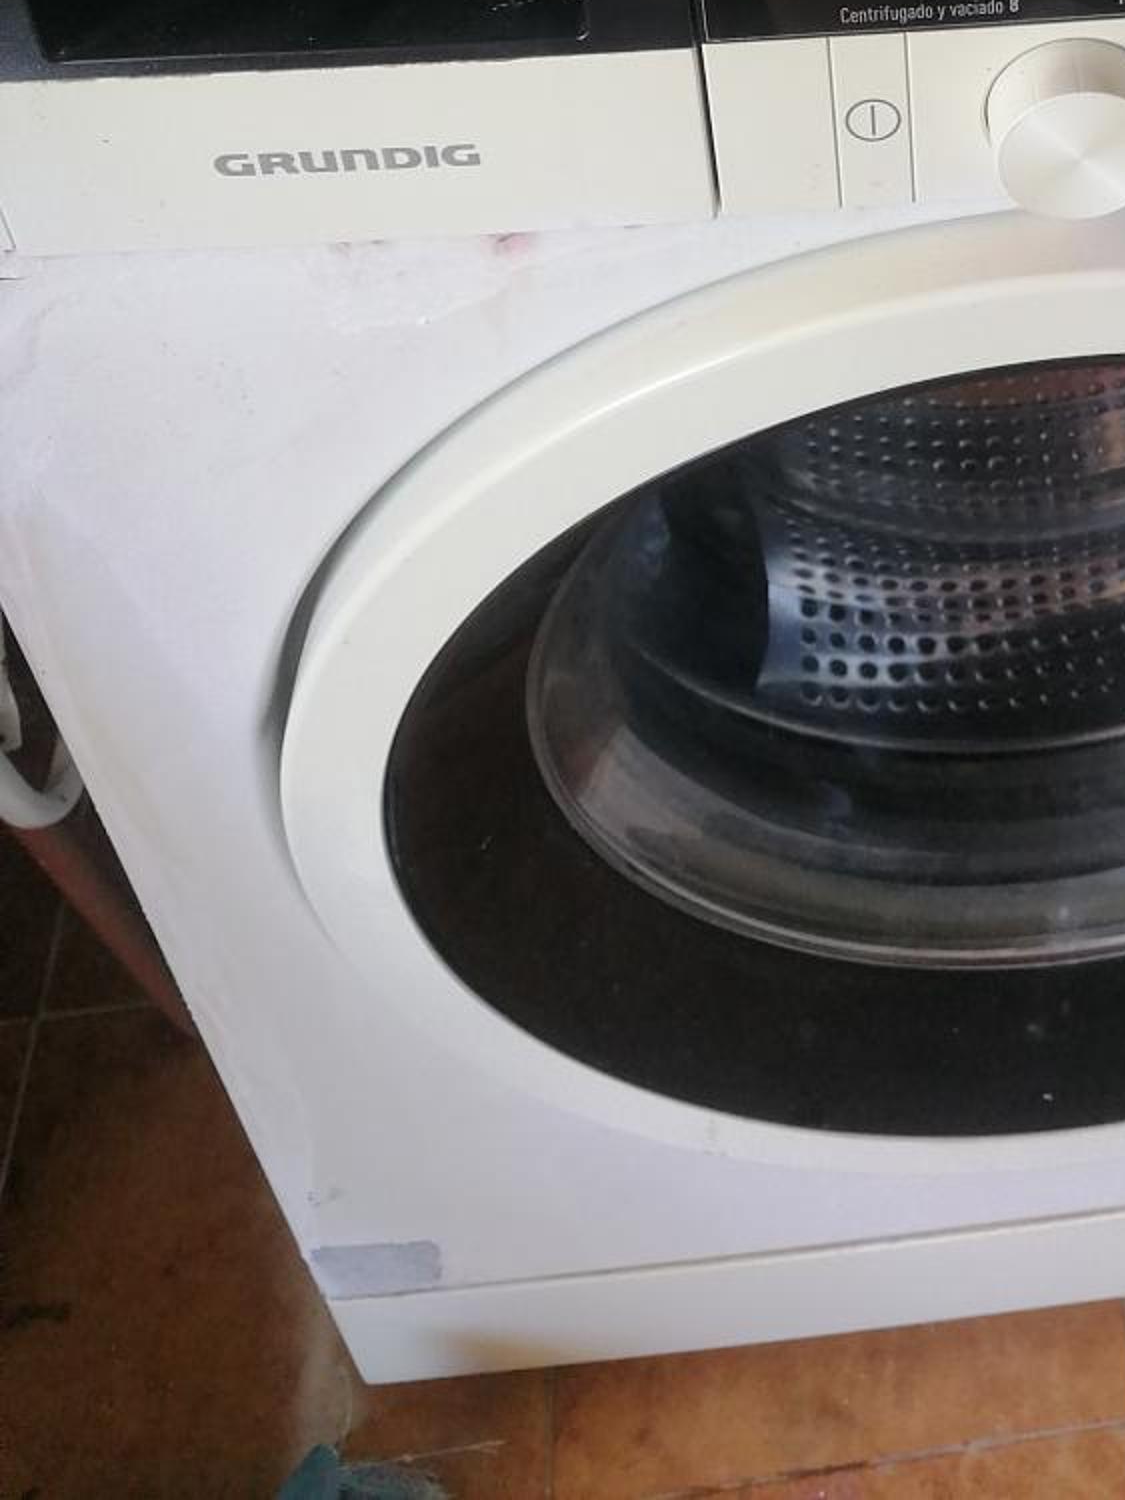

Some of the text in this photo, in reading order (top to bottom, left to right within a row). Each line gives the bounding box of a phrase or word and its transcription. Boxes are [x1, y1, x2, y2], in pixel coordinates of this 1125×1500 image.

[840, 3, 933, 24] Centrifugado
[934, 6, 945, 21] y
[950, 0, 1004, 17] vaciado
[213, 143, 481, 177] GRUNDIG
